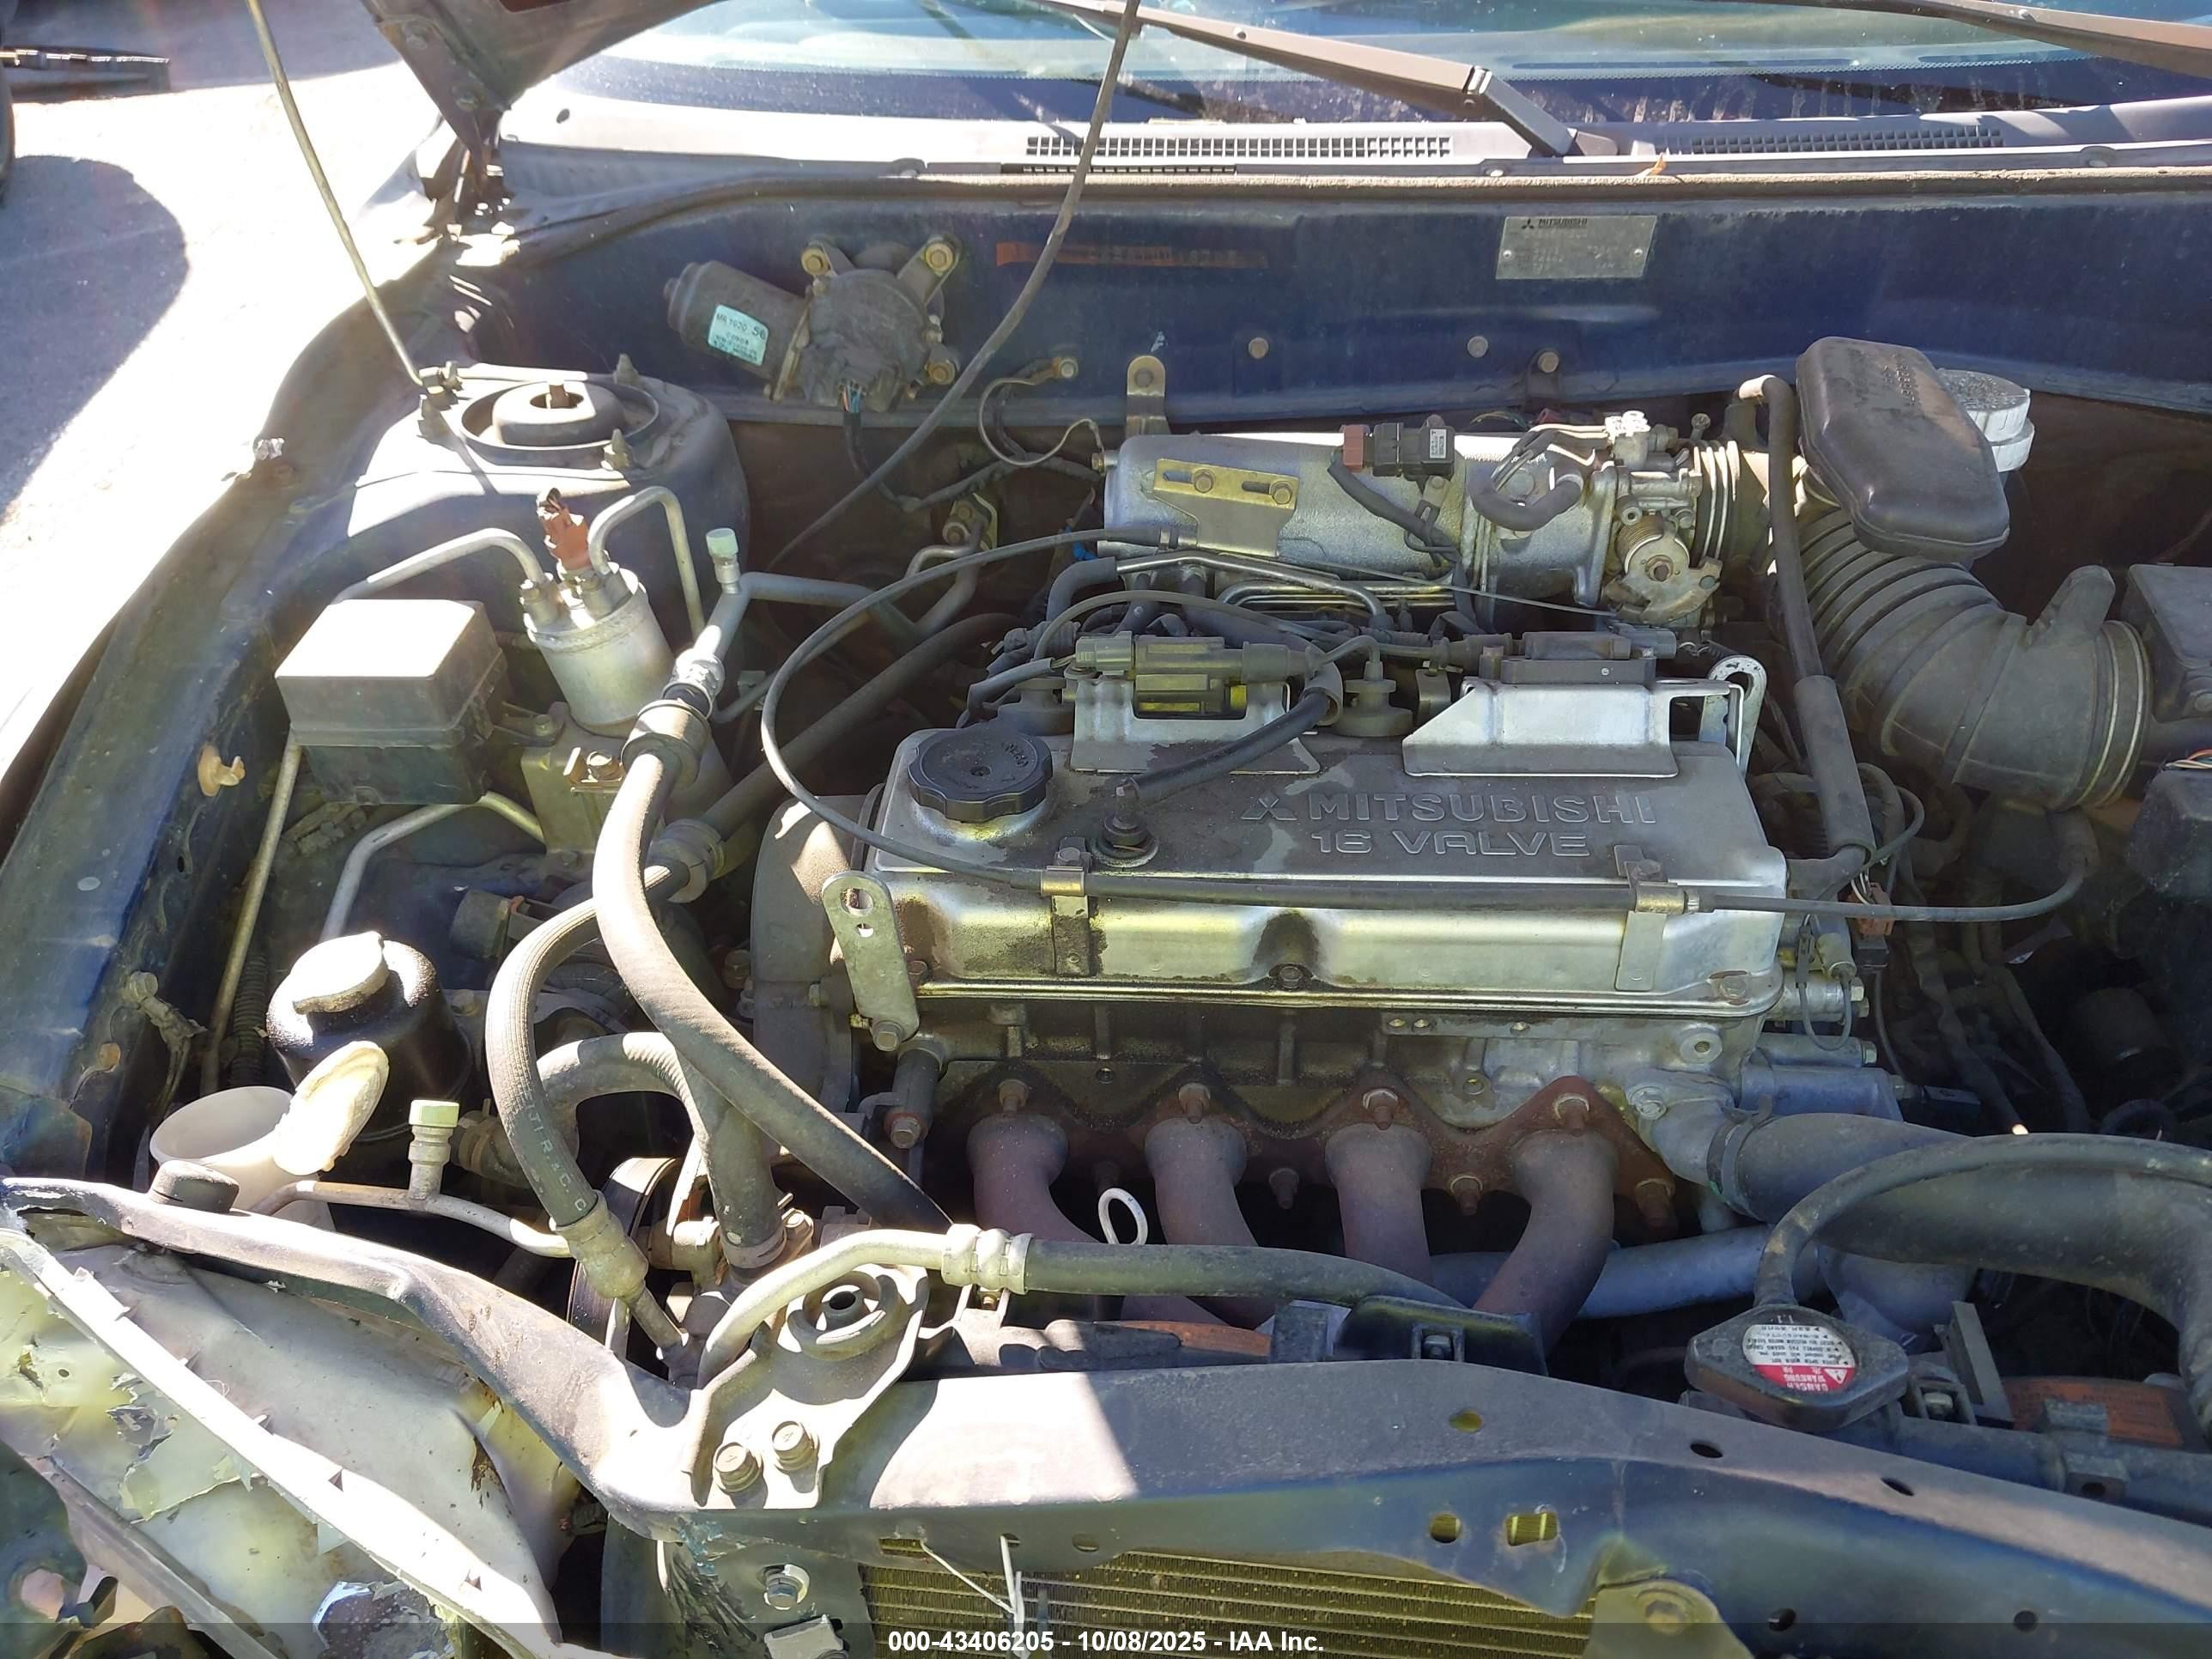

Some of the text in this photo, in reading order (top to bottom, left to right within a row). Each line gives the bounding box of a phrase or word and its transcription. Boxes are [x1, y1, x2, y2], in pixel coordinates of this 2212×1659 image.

[1308, 793, 1656, 823] MITSUBISHI
[1311, 830, 1590, 856] 16 VALVE
